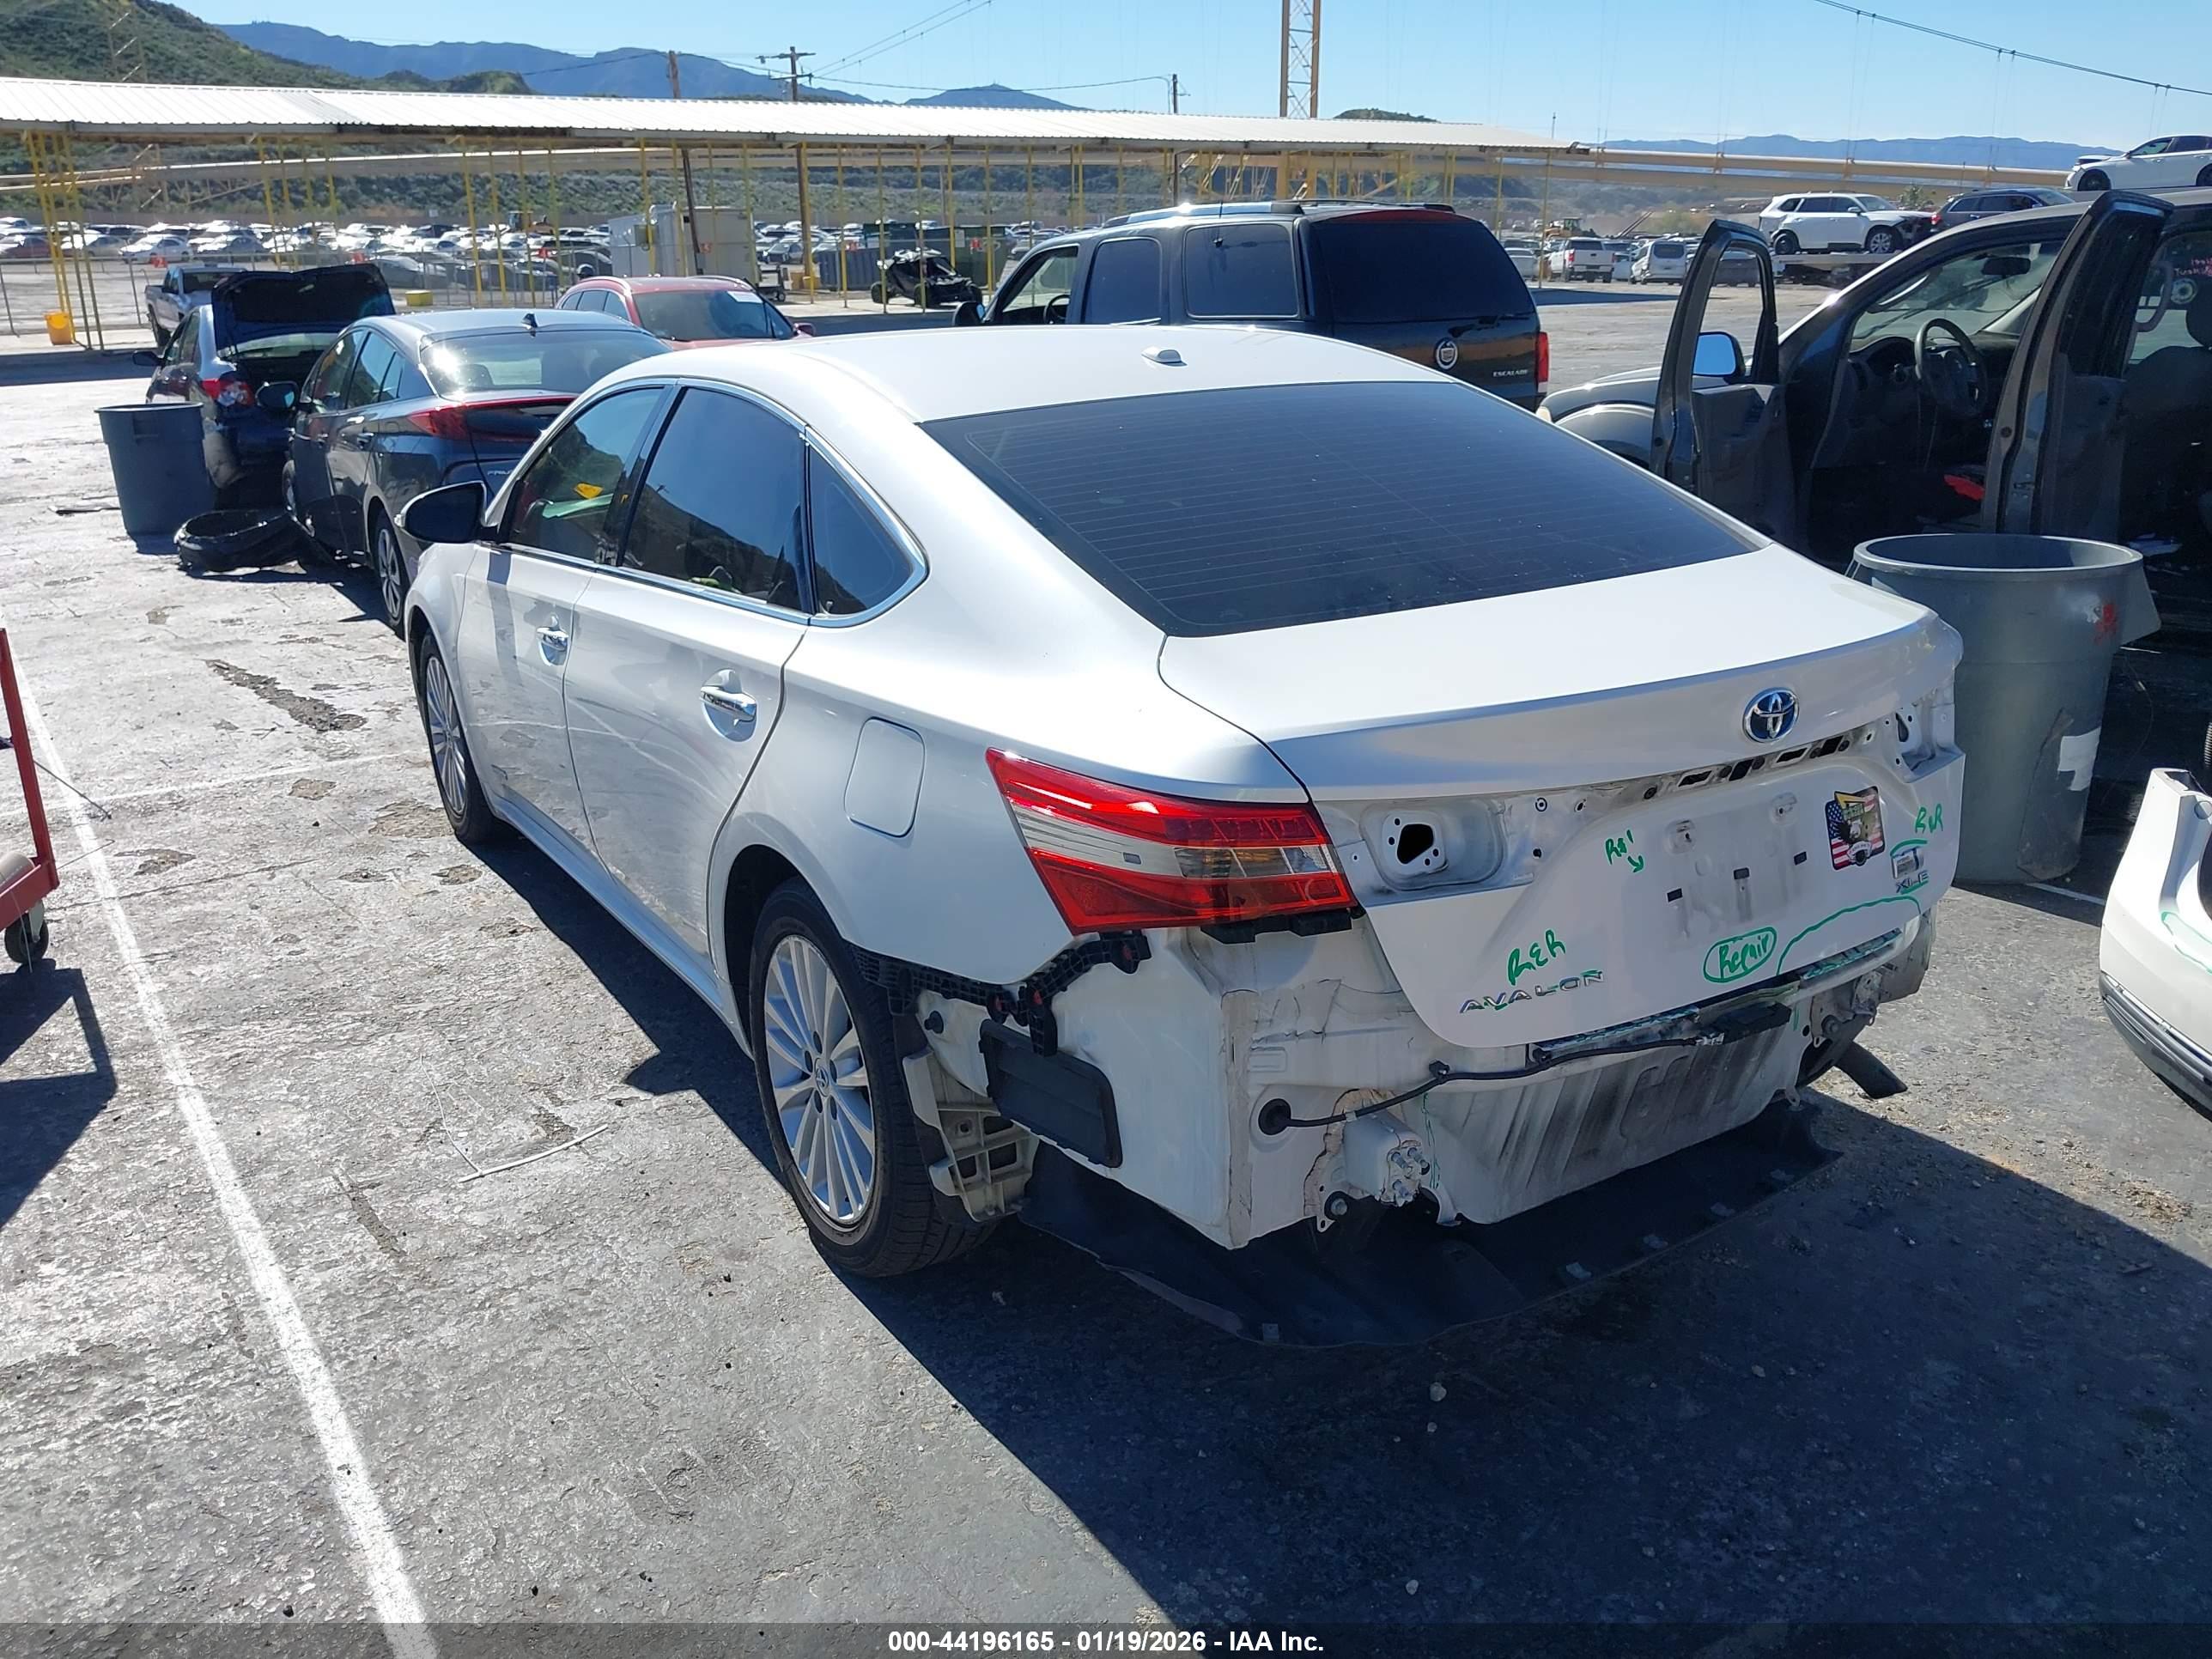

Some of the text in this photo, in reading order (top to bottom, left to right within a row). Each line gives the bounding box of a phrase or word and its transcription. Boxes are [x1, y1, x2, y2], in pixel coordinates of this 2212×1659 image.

[1896, 870, 1929, 893] XLE
[1718, 933, 1769, 980] Repair
[1460, 969, 1604, 1014] AVALON
